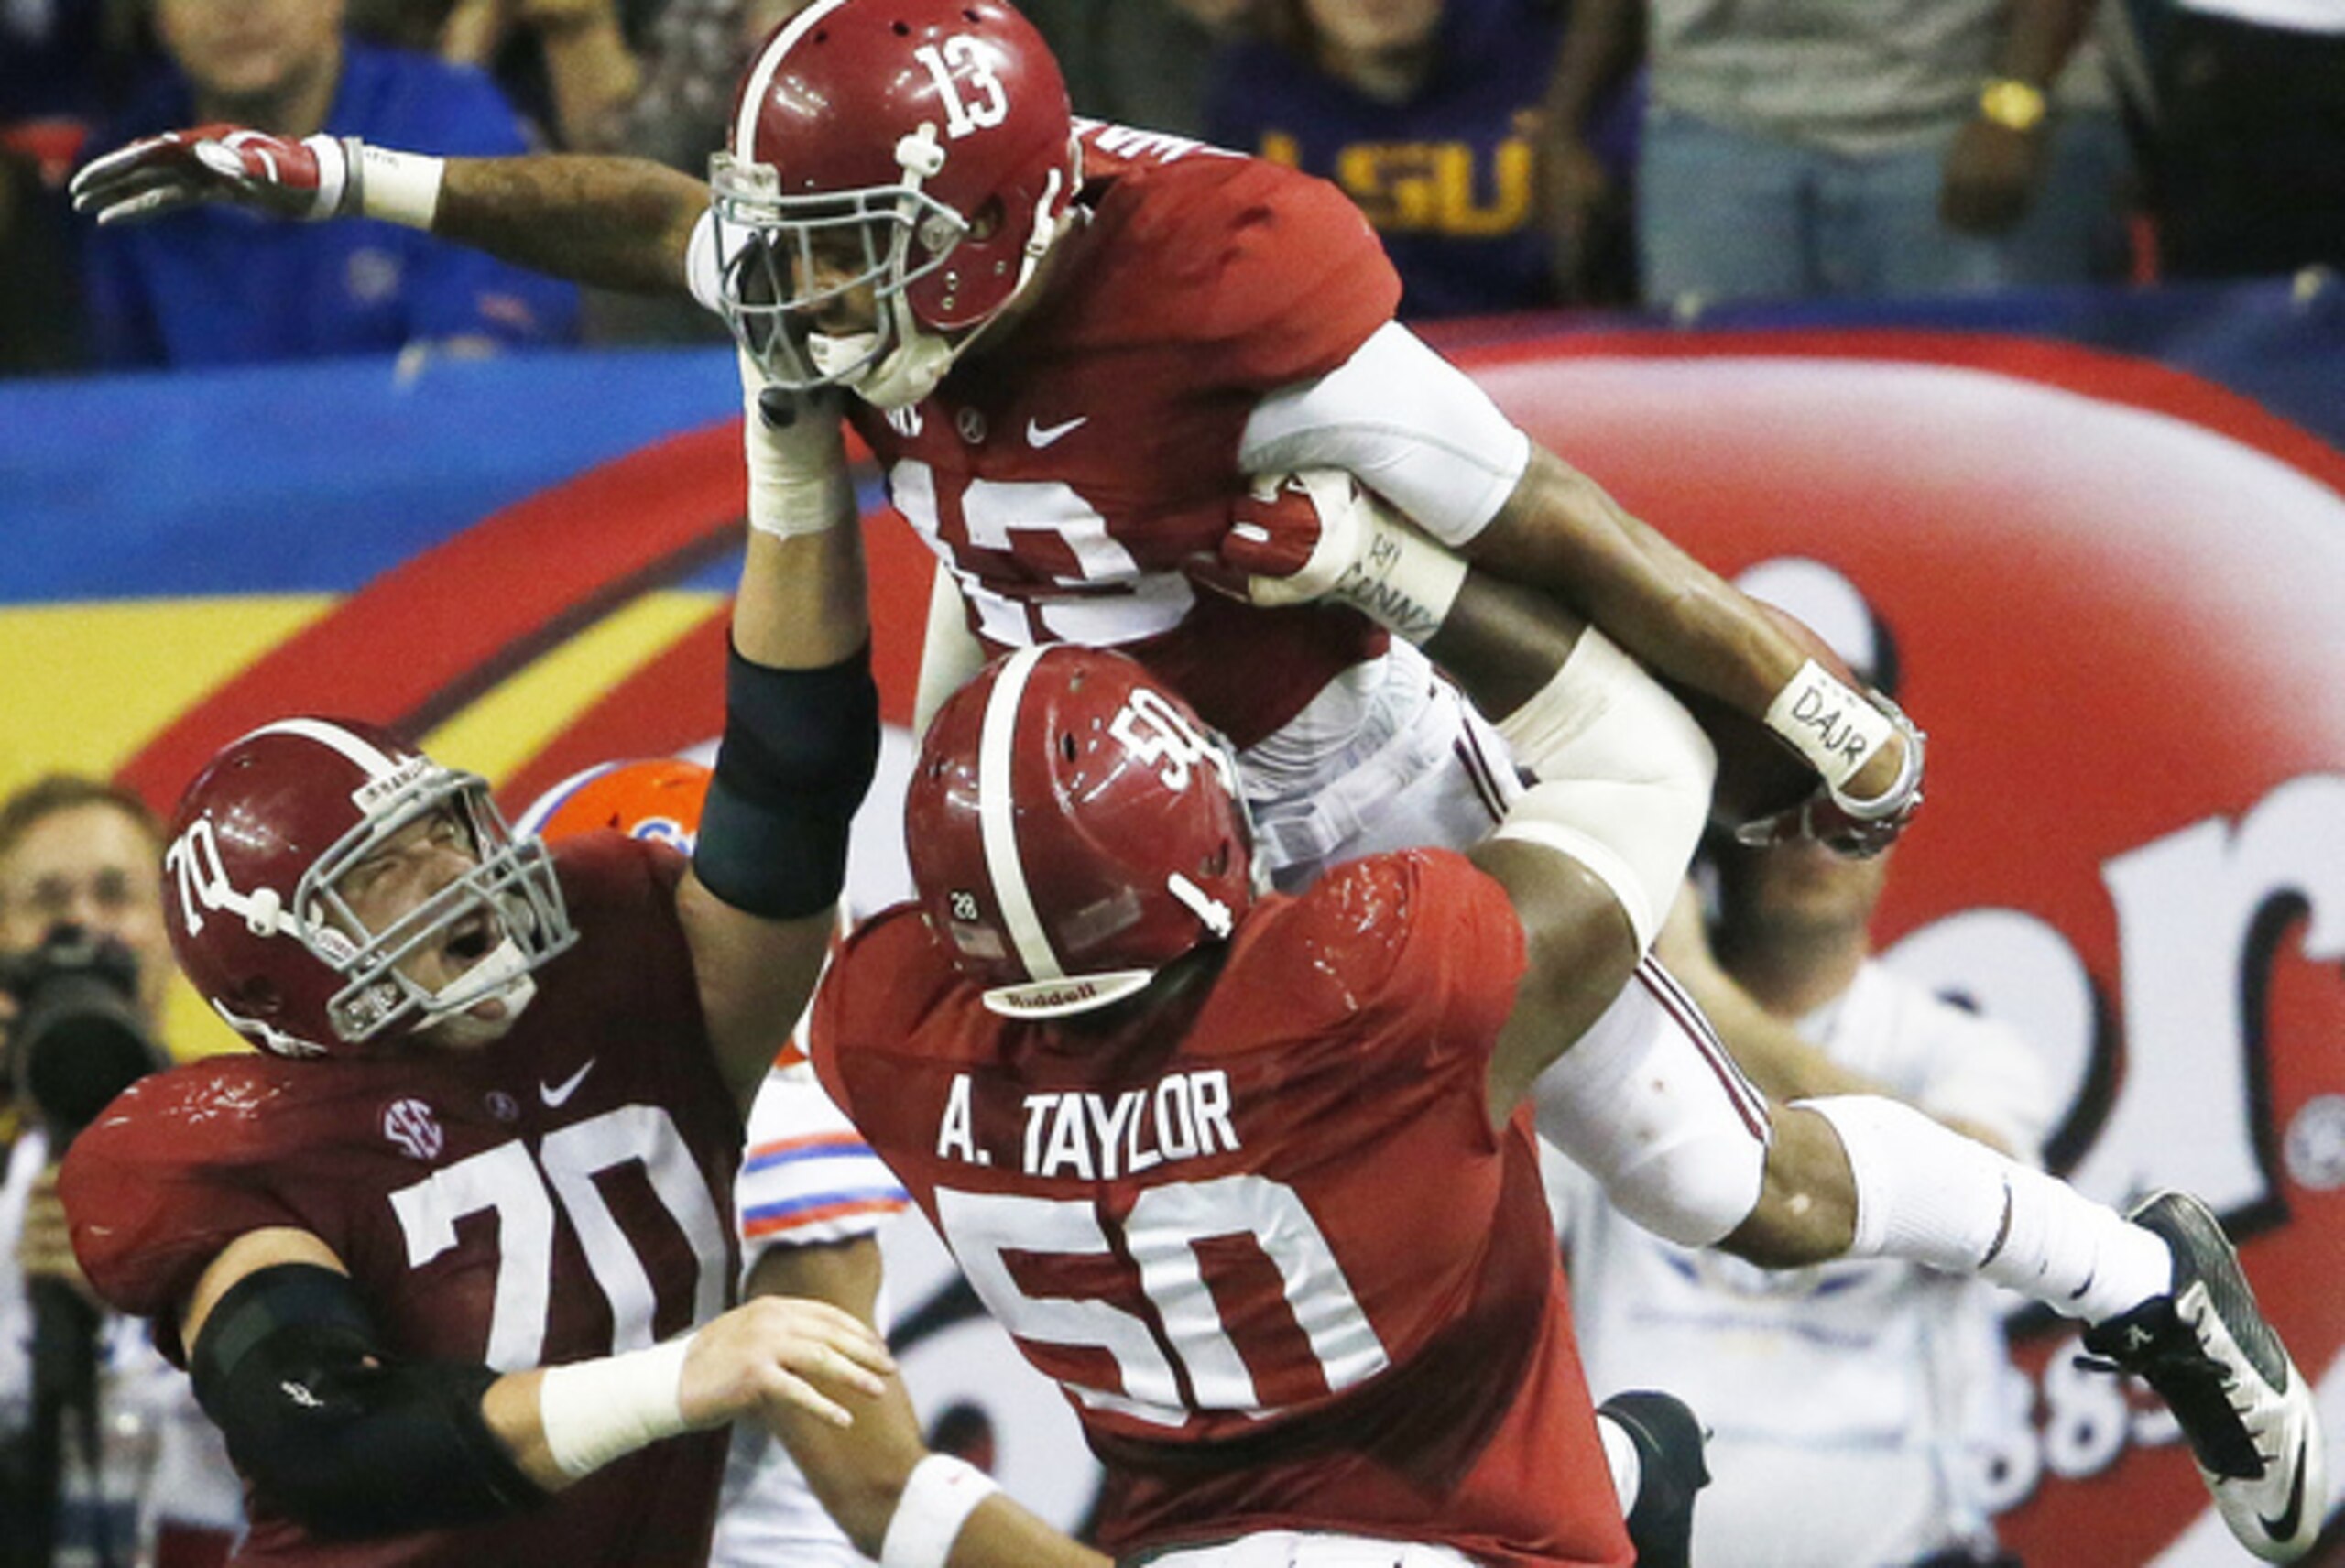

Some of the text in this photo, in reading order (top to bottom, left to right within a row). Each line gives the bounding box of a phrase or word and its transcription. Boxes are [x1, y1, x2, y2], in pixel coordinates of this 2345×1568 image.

[914, 34, 1009, 140] 13
[1262, 133, 1532, 235] SU
[889, 458, 1195, 647] 13
[1109, 688, 1207, 792] 50
[1793, 686, 1868, 767] DAJR
[166, 818, 231, 937] 70
[950, 892, 978, 920] 28
[1006, 982, 1097, 1009] Riddell
[937, 1070, 1241, 1180] A. TAYLOR
[388, 1104, 727, 1373] 70
[933, 1173, 1391, 1429] 50
